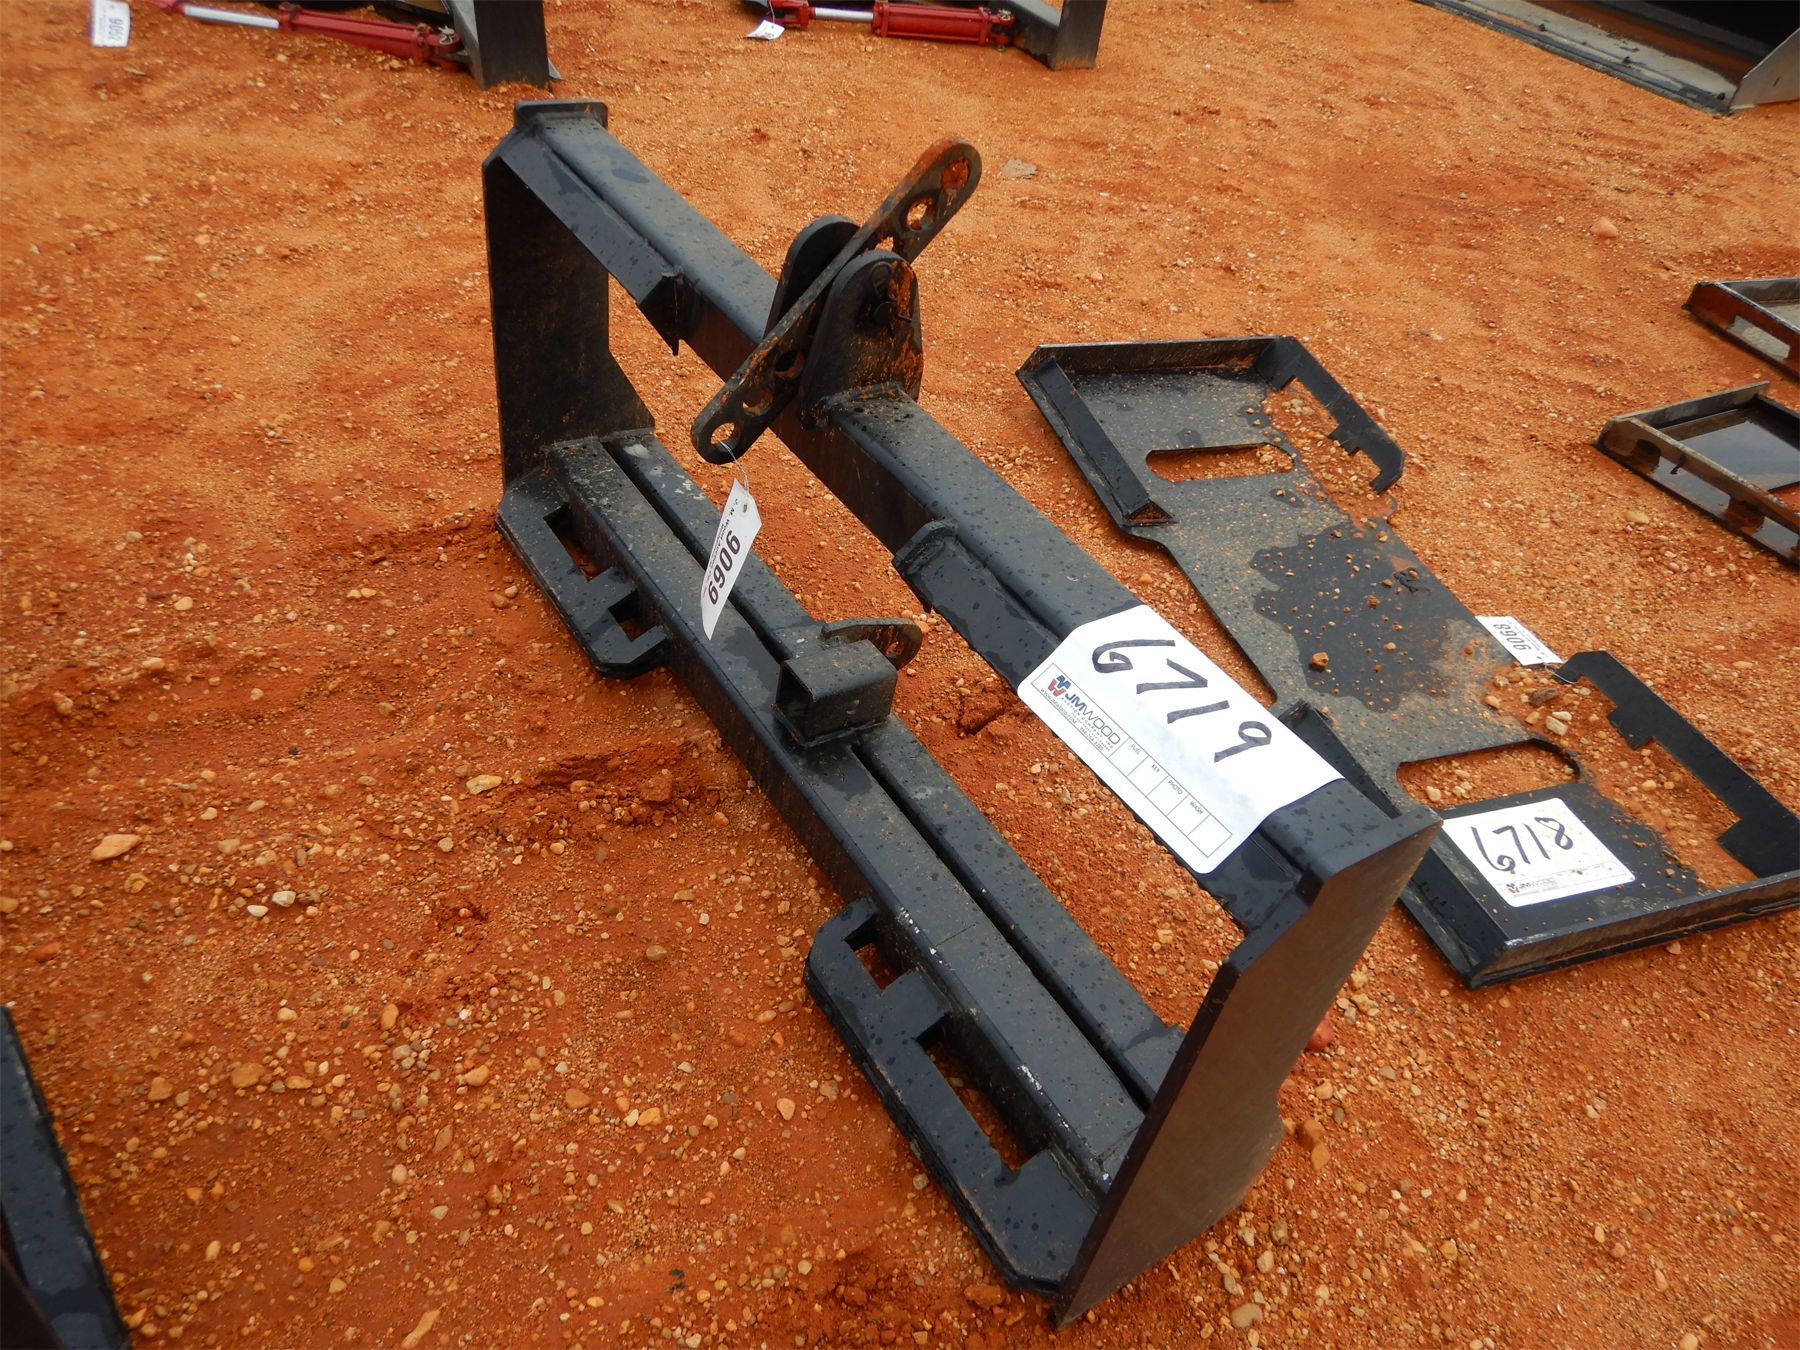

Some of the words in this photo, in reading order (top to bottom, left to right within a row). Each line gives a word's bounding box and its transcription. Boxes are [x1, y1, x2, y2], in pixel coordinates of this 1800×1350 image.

[708, 530, 741, 605] 9069
[1092, 639, 1272, 763] 6719
[1065, 693, 1121, 745] JMWOOD
[1131, 744, 1141, 755] FUEL
[1151, 764, 1160, 772] KEY
[1168, 780, 1183, 795] PHOTO
[1190, 801, 1204, 815] WASH
[1471, 816, 1573, 872] 6718
